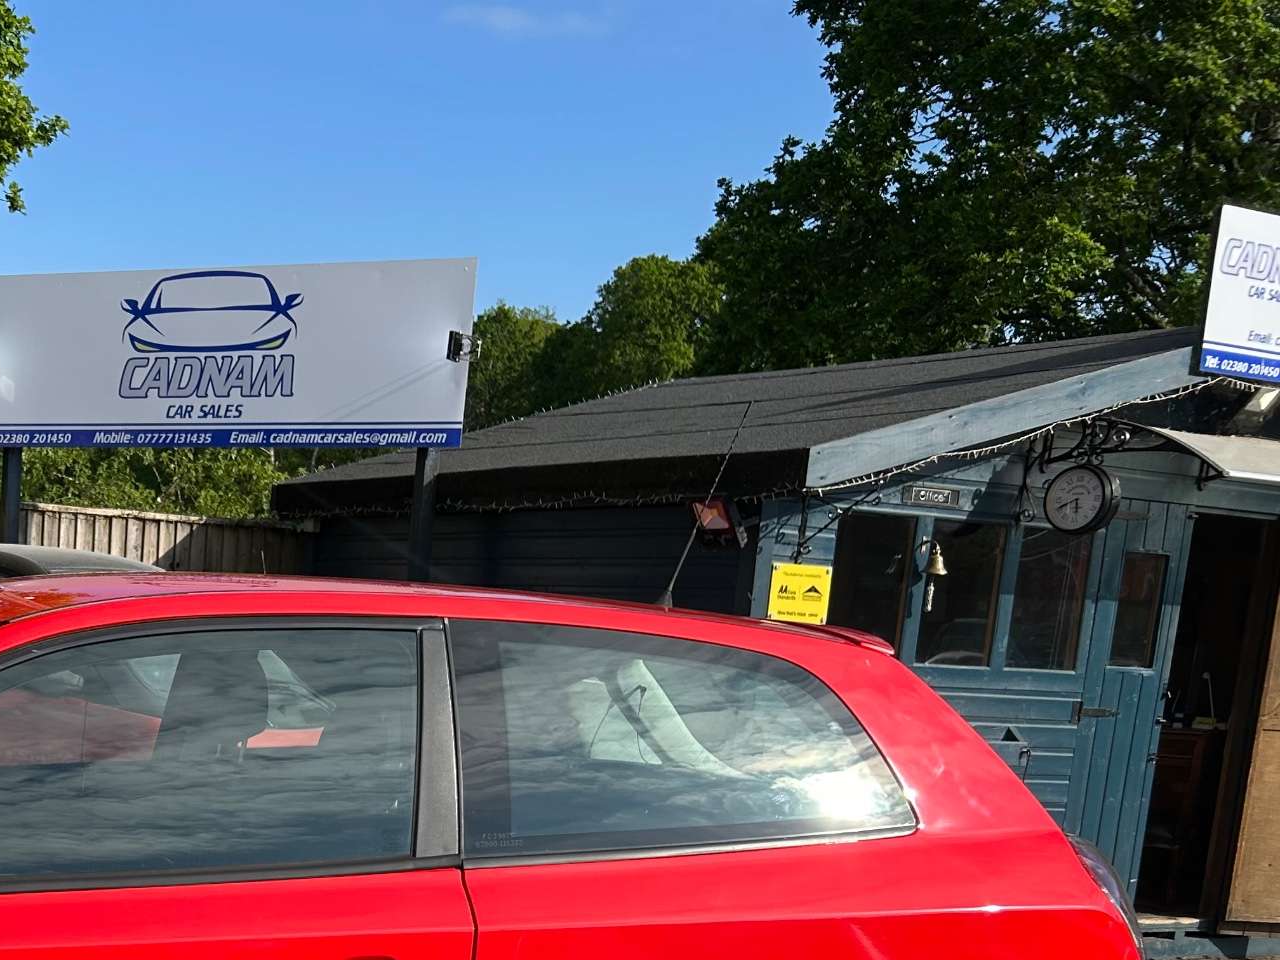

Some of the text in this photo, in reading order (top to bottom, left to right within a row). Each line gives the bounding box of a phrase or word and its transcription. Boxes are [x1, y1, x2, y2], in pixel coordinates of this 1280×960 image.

[1248, 285, 1266, 300] CAR
[1204, 355, 1280, 378] Tel: 02380 201450
[118, 354, 295, 399] CADNAM
[166, 404, 244, 419] CAR SALES
[32, 433, 72, 444] 201450
[93, 432, 135, 444] Mobile:
[137, 432, 213, 444] 07777131435
[229, 431, 267, 444] Email:
[269, 430, 448, 446] cadnamcarsales@gmail.com
